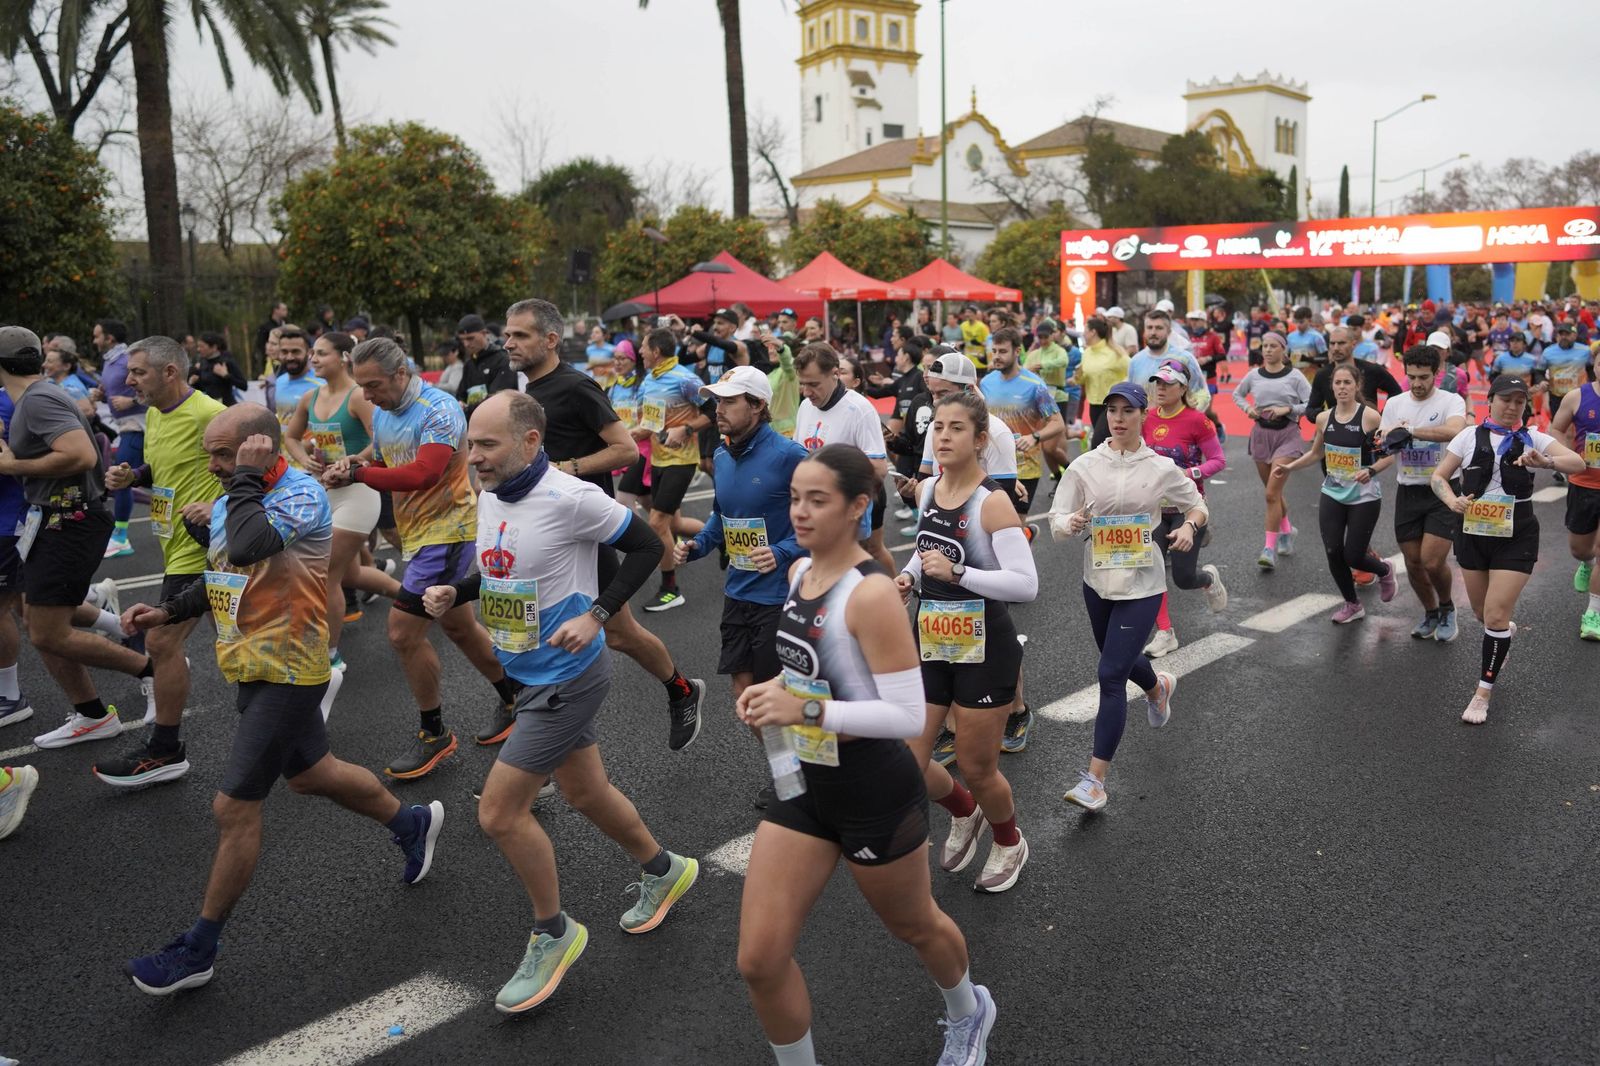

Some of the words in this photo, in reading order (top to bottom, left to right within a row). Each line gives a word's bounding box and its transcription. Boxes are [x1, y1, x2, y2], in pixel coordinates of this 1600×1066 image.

[1486, 224, 1550, 246] HOKA
[1328, 452, 1355, 467] 17293
[151, 498, 168, 515] 237
[1470, 503, 1506, 519] 16527
[725, 529, 759, 548] 15406
[1097, 527, 1141, 545] 14891
[209, 588, 232, 613] 6553
[481, 594, 525, 620] 12520
[922, 615, 974, 636] 14065
